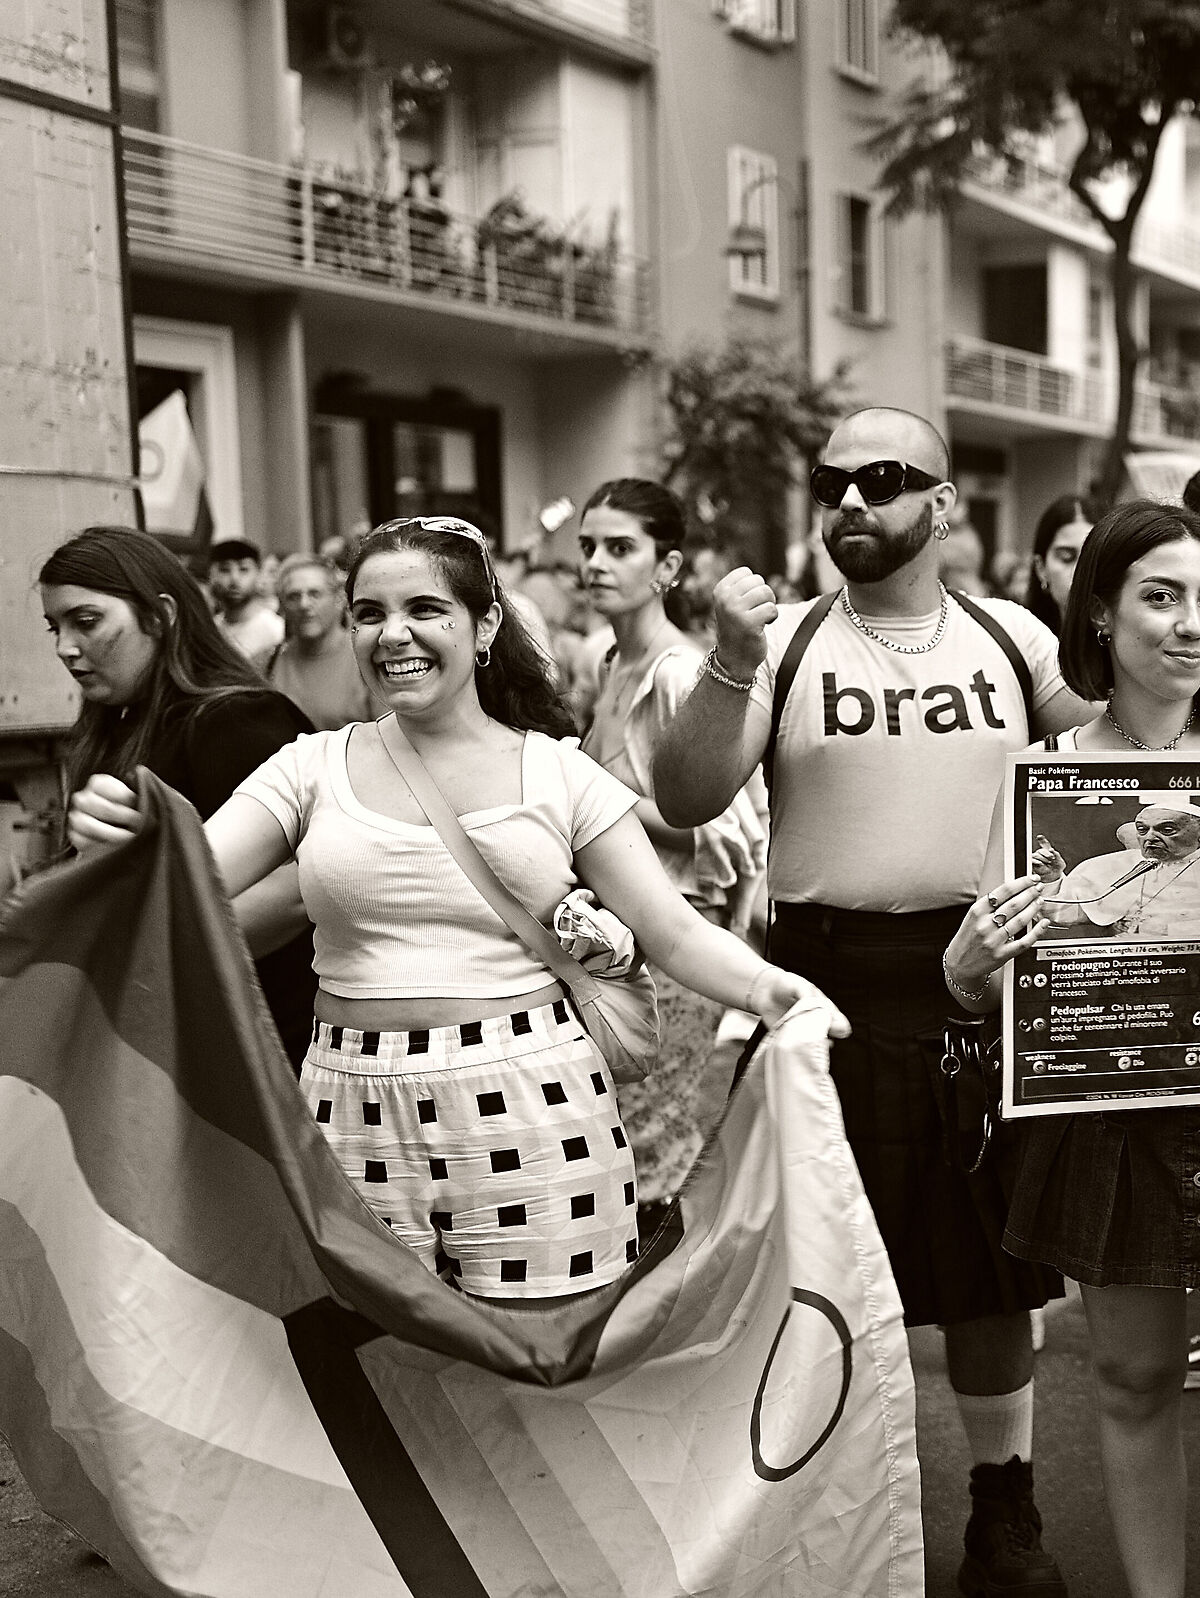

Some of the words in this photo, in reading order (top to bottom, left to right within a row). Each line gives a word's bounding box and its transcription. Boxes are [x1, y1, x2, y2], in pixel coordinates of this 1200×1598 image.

[822, 669, 1006, 736] brat
[1028, 767, 1046, 775] Basic
[1048, 766, 1080, 775] Pokémon
[1028, 776, 1064, 792] Papa
[1069, 775, 1140, 789] Francesco
[1168, 776, 1192, 789] 666
[1109, 947, 1133, 955] Length:
[1161, 945, 1186, 953] Weight:
[1051, 960, 1111, 972] Frociopugno
[1112, 959, 1142, 968] Durante
[1051, 972, 1085, 981] prossimo
[1122, 968, 1128, 976] il
[1128, 967, 1149, 975] twink
[1150, 966, 1187, 975] avversario
[1051, 980, 1071, 989] verrà
[1072, 980, 1101, 988] bruciato
[1152, 976, 1160, 984] di
[1051, 989, 1089, 997] Francesco.
[1050, 1004, 1105, 1017] Pedopulsar
[1111, 1004, 1125, 1012] Chi
[1078, 1014, 1118, 1024] impregnata
[1118, 1012, 1126, 1021] di
[1159, 1010, 1175, 1018] Può
[1050, 1025, 1072, 1033] anche
[1073, 1024, 1083, 1032] far
[1123, 1021, 1130, 1029] il
[1130, 1020, 1169, 1028] minorenne
[1025, 1053, 1056, 1062] weakness
[1109, 1049, 1142, 1057] resistance
[1047, 1062, 1087, 1072] Frociaggine
[1132, 1059, 1145, 1067] Dio
